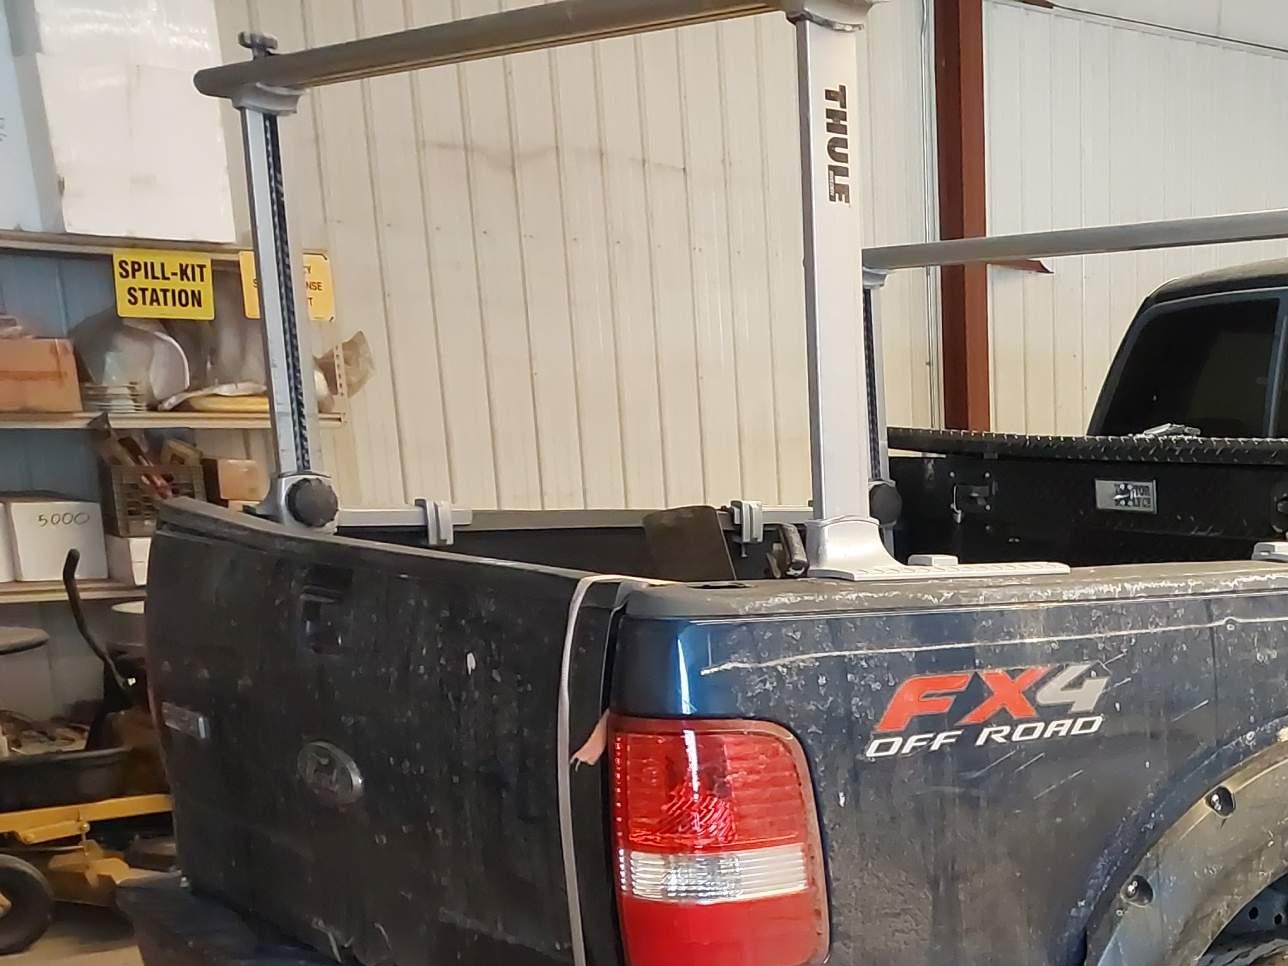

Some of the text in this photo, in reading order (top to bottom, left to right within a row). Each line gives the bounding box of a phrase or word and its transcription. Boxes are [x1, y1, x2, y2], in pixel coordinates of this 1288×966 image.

[824, 84, 850, 203] THULE
[118, 259, 207, 283] SPILL-KIT
[127, 286, 203, 308] STATION
[38, 512, 90, 527] 5000
[873, 659, 1112, 732] FX4
[865, 714, 1105, 757] OFF ROAD
